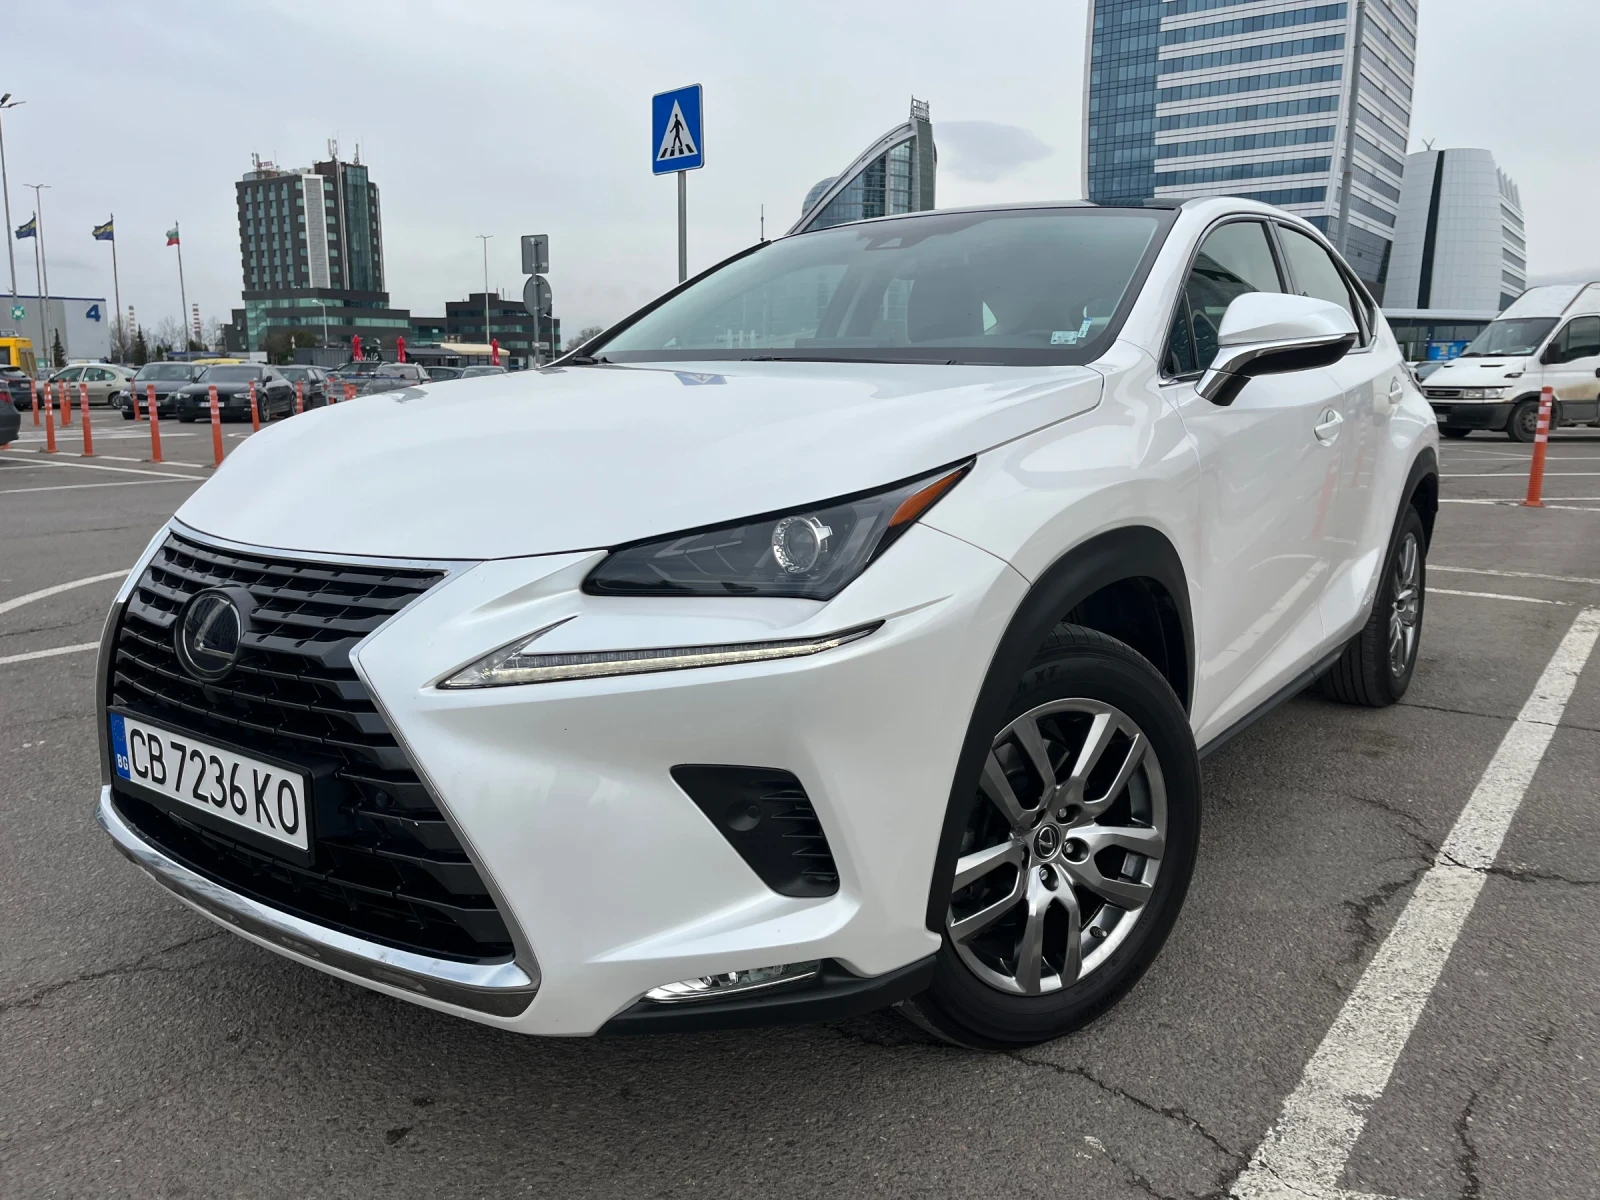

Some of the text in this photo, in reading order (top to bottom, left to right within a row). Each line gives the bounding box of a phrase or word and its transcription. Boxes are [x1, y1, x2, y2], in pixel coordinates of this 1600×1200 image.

[86, 304, 101, 322] 4
[117, 753, 129, 771] BG
[170, 741, 247, 816] 7236
